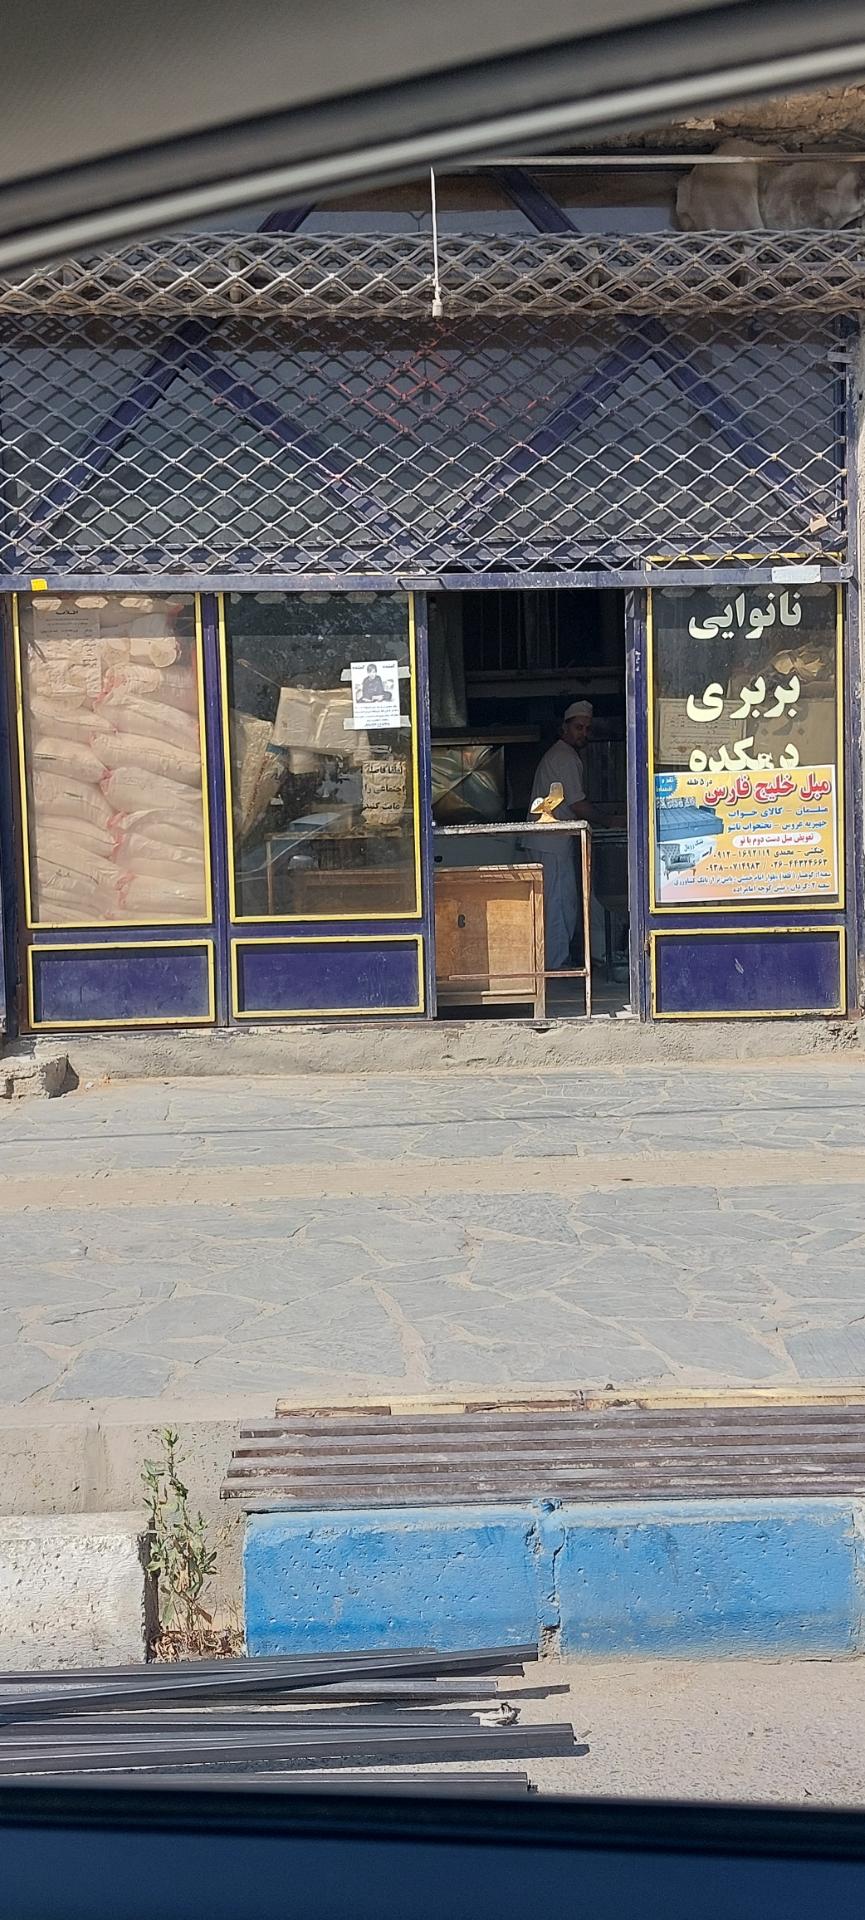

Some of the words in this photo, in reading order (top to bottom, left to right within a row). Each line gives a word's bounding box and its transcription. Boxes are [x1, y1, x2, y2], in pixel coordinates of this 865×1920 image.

[688, 592, 802, 639] نانوایی
[686, 676, 801, 722] بربری
[688, 736, 800, 772] دهکده
[373, 783, 405, 795] اجتماعی
[704, 775, 751, 806] فارس
[754, 773, 796, 803] خلیج
[799, 772, 832, 800] مبل
[728, 809, 758, 819] خواب
[760, 807, 783, 818] کالای
[795, 805, 829, 816] مبلمان
[782, 821, 803, 830] عروس
[752, 837, 764, 846] دوم
[781, 834, 793, 844] مبل
[794, 832, 814, 843] تعویض
[773, 850, 794, 858] محمدی
